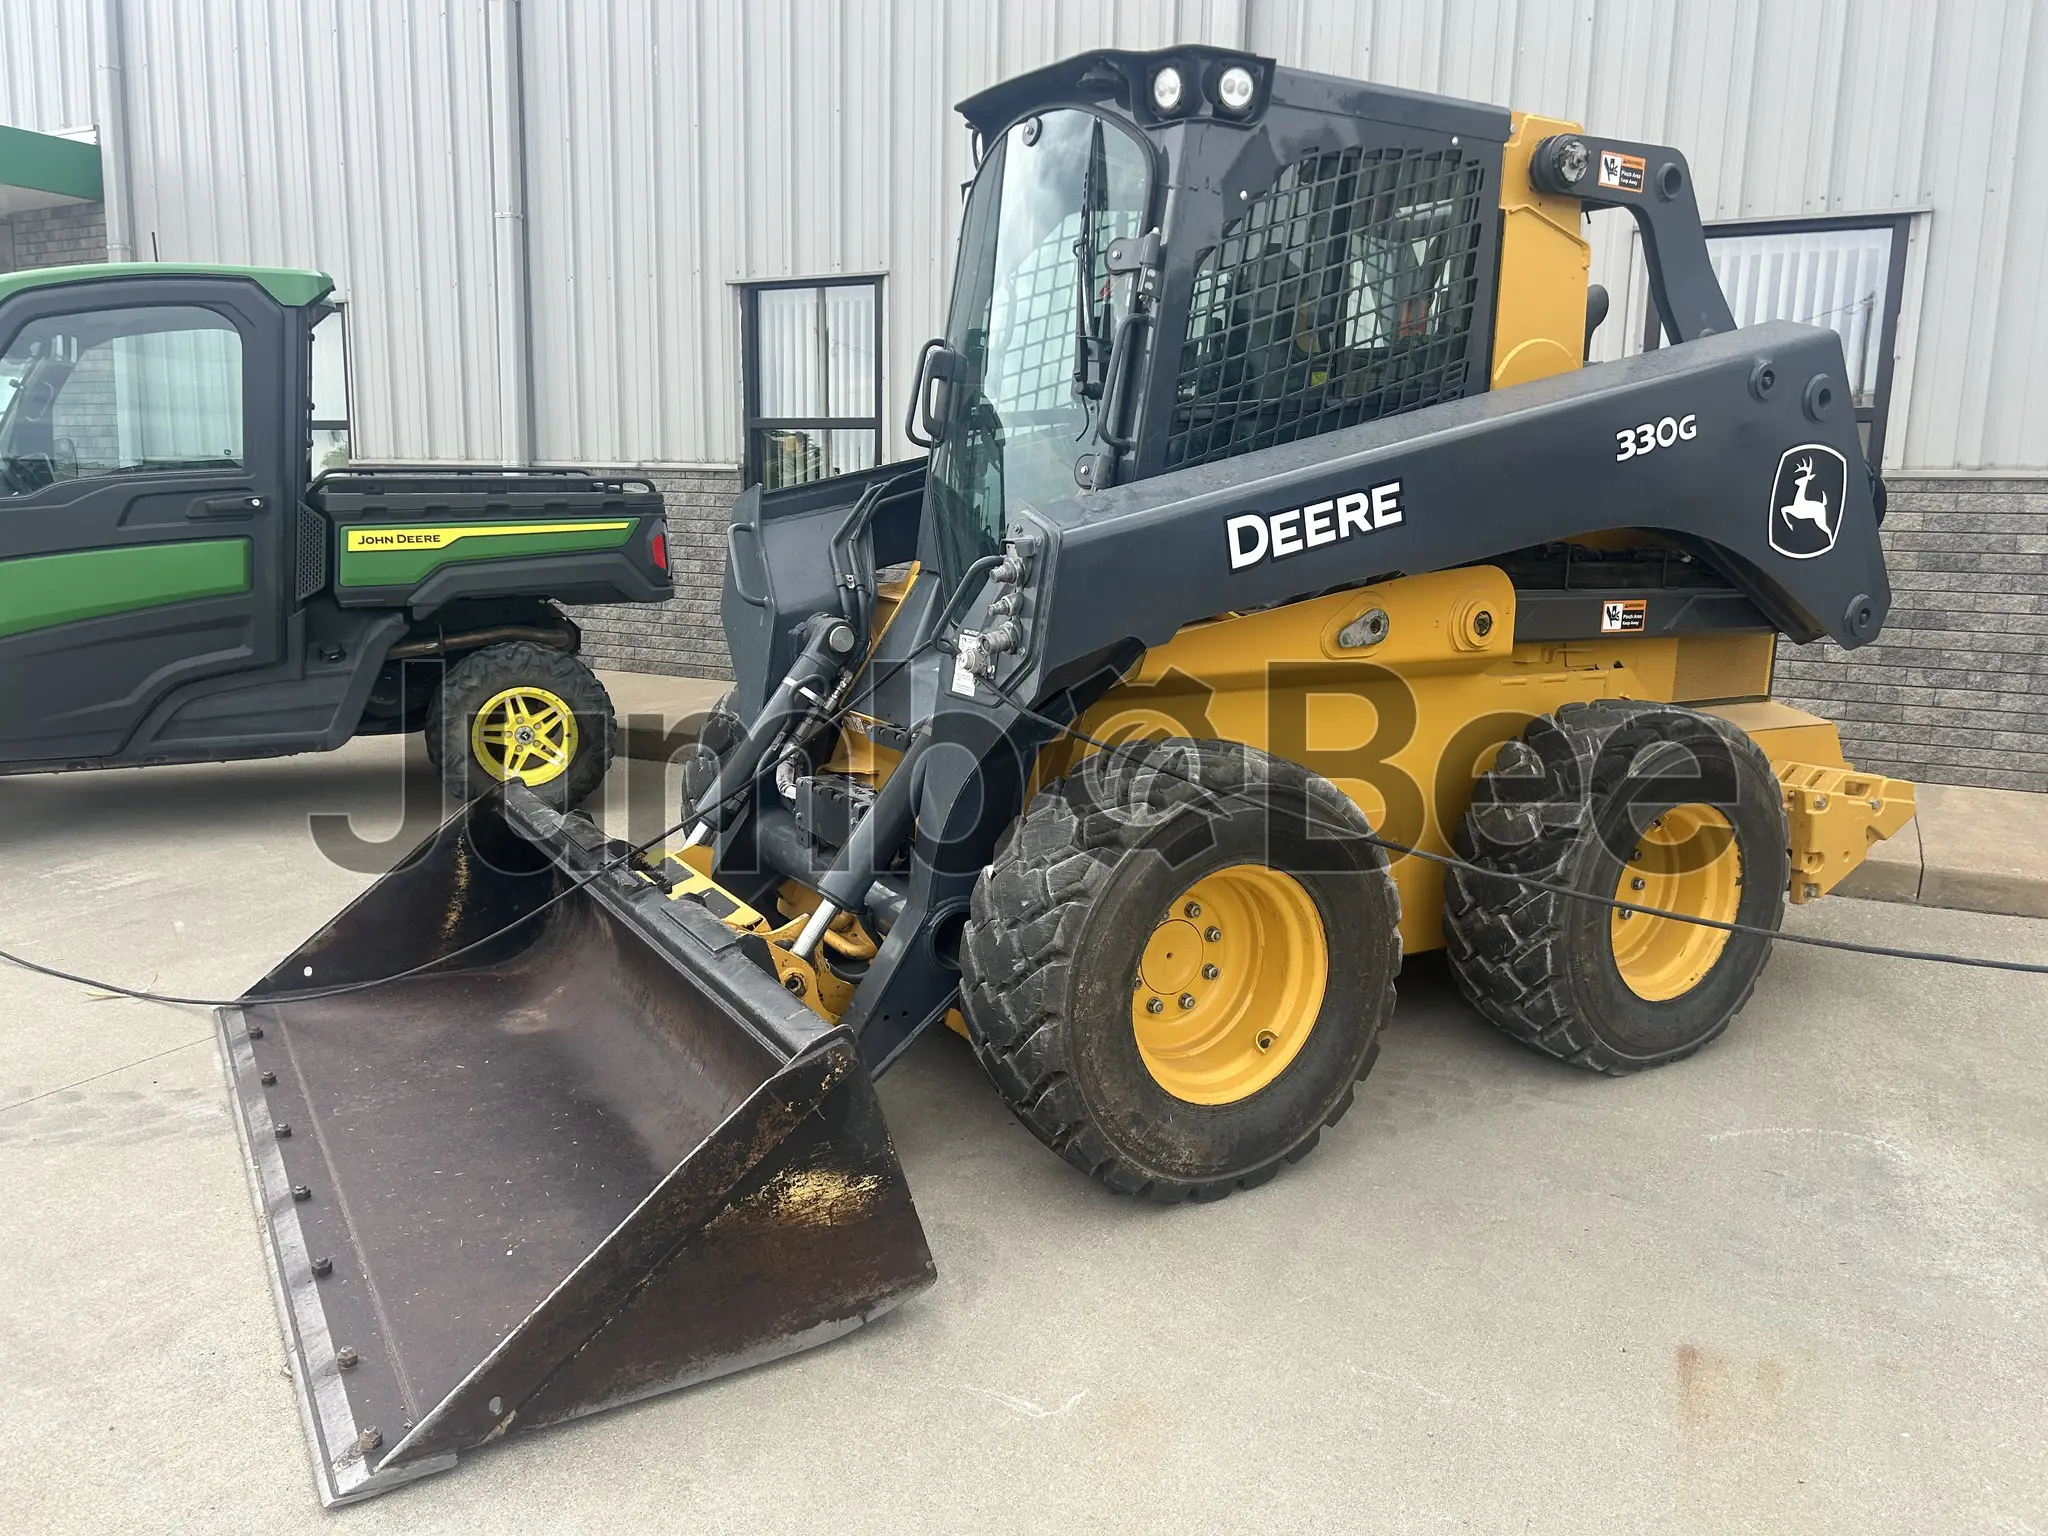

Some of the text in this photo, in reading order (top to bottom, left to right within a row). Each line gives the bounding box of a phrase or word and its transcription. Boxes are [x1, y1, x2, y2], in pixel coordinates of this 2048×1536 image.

[1616, 414, 1697, 462] 330G
[358, 534, 441, 545] JOHN DEERE
[1226, 481, 1403, 570] DEERE
